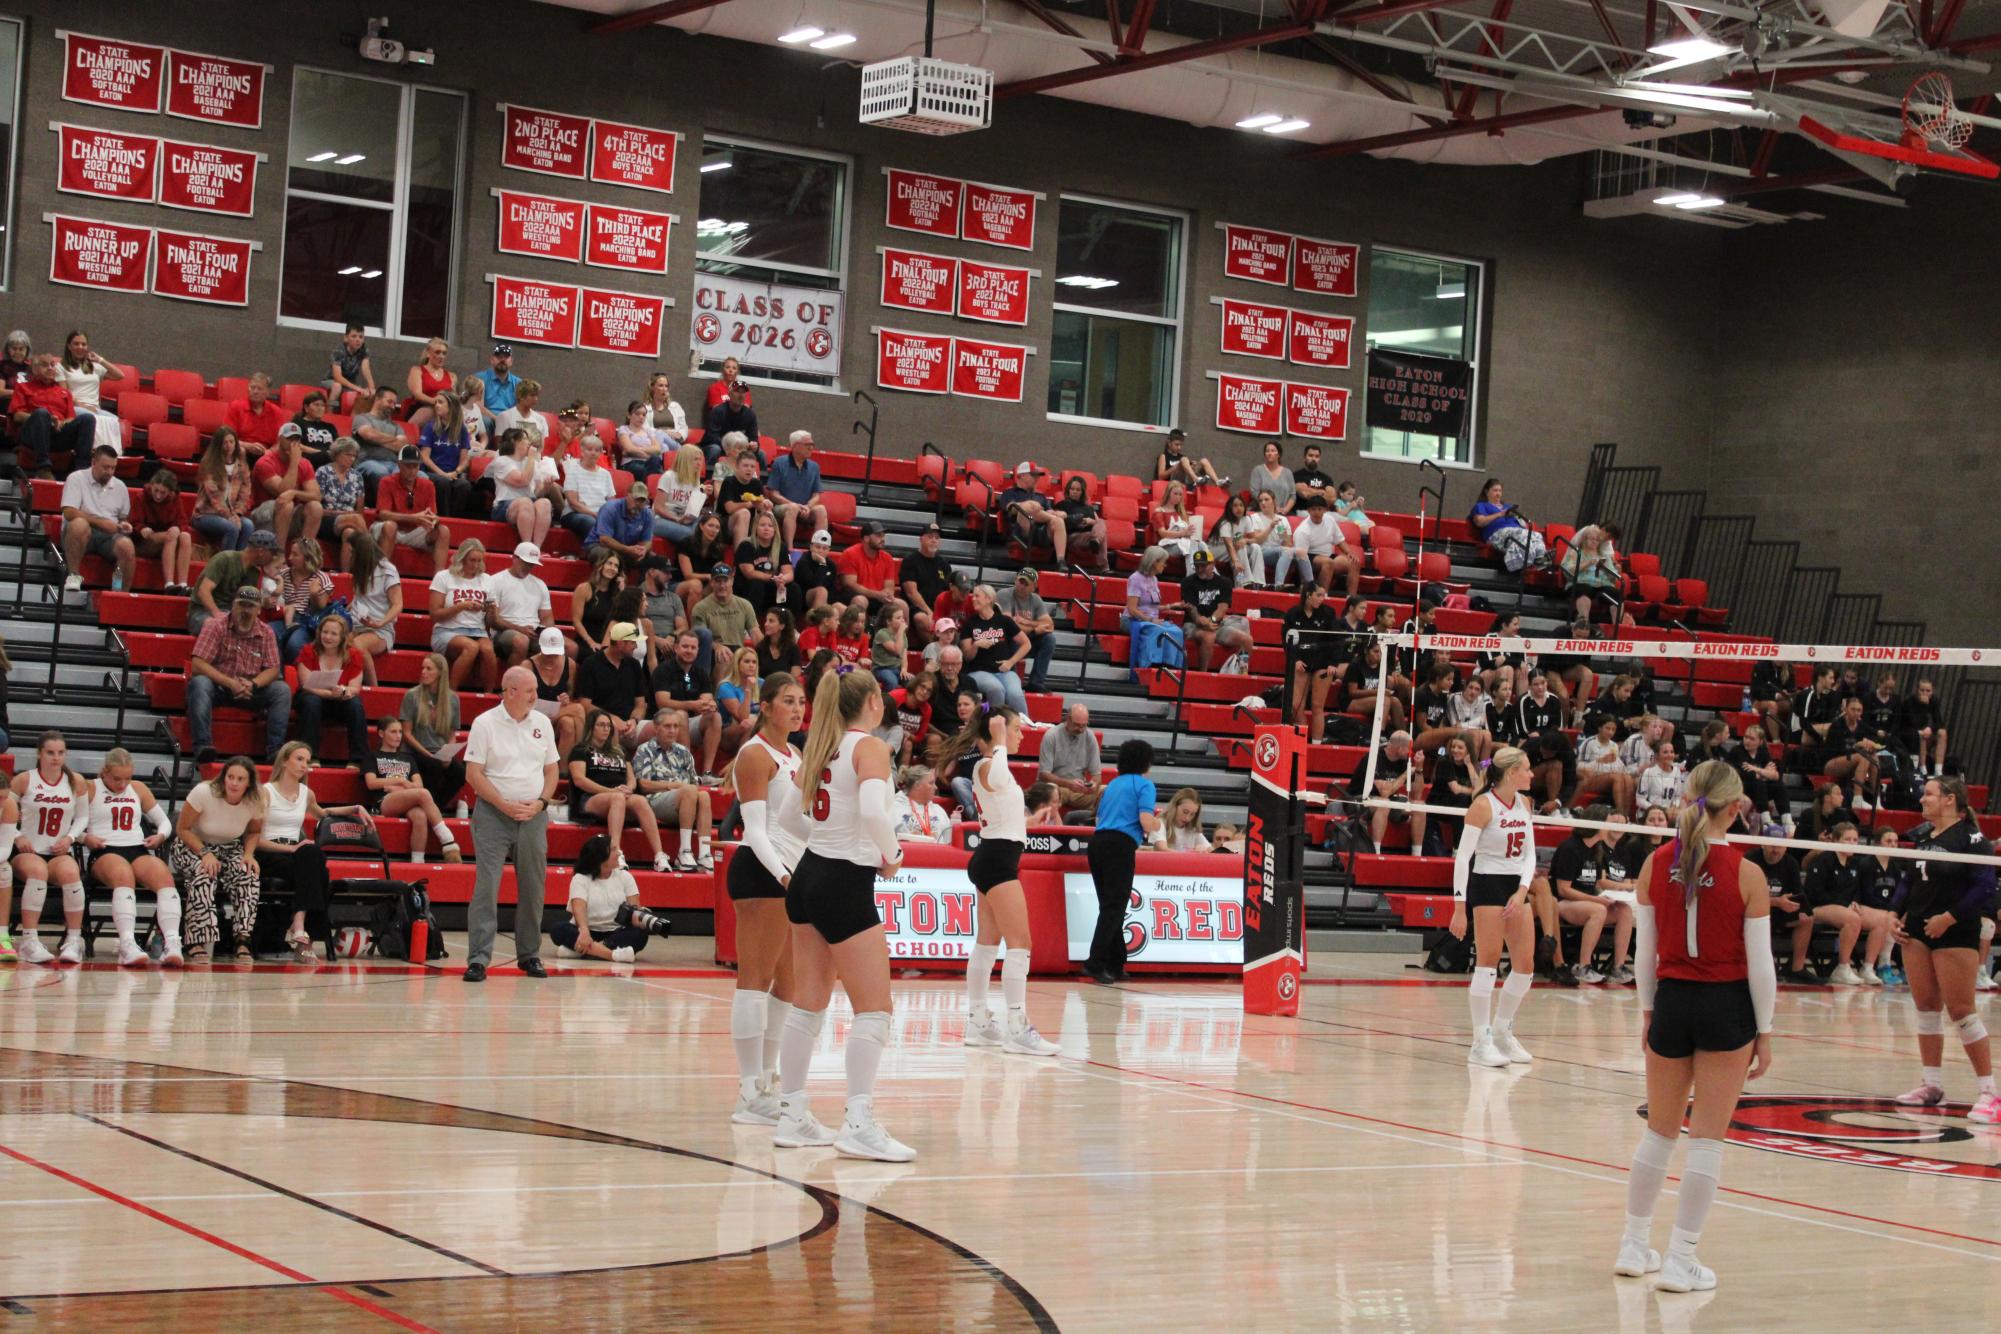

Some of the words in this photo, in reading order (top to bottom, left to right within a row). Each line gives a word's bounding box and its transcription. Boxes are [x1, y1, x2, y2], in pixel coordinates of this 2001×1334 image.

[100, 45, 129, 59] STATE
[77, 48, 151, 79] CHAMPIONS
[201, 62, 229, 74] STATE
[90, 69, 113, 80] 2020
[116, 74, 135, 85] AAA
[179, 65, 250, 94] CHAMPIONS
[92, 80, 131, 94] SOFTBALL
[193, 85, 213, 97] 2021
[216, 89, 234, 100] AAA
[100, 91, 122, 101] EATON
[194, 96, 232, 109] BASEBALL
[201, 107, 223, 117] EATON
[534, 116, 560, 128] STATE
[515, 119, 539, 138] 2ND
[542, 127, 578, 148] PLACE
[624, 130, 648, 143] STATE
[94, 136, 124, 149] STATE
[529, 138, 547, 149] 2021
[550, 142, 561, 152] AA
[604, 135, 627, 152] 4TH
[630, 142, 666, 161] PLACE
[72, 139, 145, 168] CHAMPIONS
[194, 151, 222, 163] STATE
[517, 145, 552, 159] MARCHING
[554, 154, 572, 162] BAND
[84, 160, 107, 171] 2020
[111, 164, 130, 175] AAA
[172, 154, 243, 183] CHAMPIONS
[534, 158, 553, 168] EATON
[612, 161, 630, 171] BOYS
[633, 165, 654, 175] TRACK
[83, 170, 131, 184] VOLLEYBALL
[189, 175, 208, 186] 2021
[211, 178, 223, 188] AA
[623, 171, 642, 181] EATON
[94, 181, 117, 192] EATON
[915, 179, 938, 190] STATE
[187, 186, 224, 198] FOOTBALL
[898, 182, 954, 207] CHAMPIONS
[990, 193, 1012, 204] STATE
[194, 195, 215, 205] EATON
[531, 201, 556, 212] STATE
[972, 195, 1026, 220] CHAMPIONS
[511, 203, 574, 230] CHAMPIONS
[618, 213, 644, 225] STATE
[909, 209, 939, 220] FOOTBALL
[982, 213, 998, 223] 2023
[1000, 216, 1013, 226] AAA
[915, 218, 932, 227] EATON
[984, 223, 1012, 234] BASEBALL
[88, 228, 117, 240] STATE
[597, 217, 629, 235] THIRD
[631, 226, 663, 242] PLACE
[990, 232, 1005, 240] EATON
[522, 231, 560, 244] WRESTLING
[65, 231, 117, 253] RUNNER
[121, 241, 139, 260] UP
[189, 241, 217, 253] STATE
[531, 241, 550, 251] EATON
[600, 243, 635, 255] MARCHING
[638, 249, 656, 258] BAND
[1232, 236, 1259, 252] FINAL
[1261, 243, 1285, 259] FOUR
[79, 251, 100, 262] 2021
[103, 254, 121, 265] AAA
[168, 244, 203, 264] FINAL
[206, 253, 238, 273] FOUR
[618, 254, 637, 263] EATON
[909, 258, 932, 269] STATE
[1302, 249, 1350, 269] CHAMPIONS
[78, 261, 121, 275] WRESTLING
[181, 264, 201, 275] 2021
[204, 267, 222, 278] AAA
[891, 260, 919, 279] FINAL
[921, 268, 948, 286] FOUR
[87, 272, 109, 282] EATON
[182, 274, 219, 287] SOFTBALL
[984, 271, 1005, 280] STATE
[189, 285, 210, 295] EATON
[966, 274, 987, 290] 3RD
[990, 280, 1019, 296] PLACE
[524, 286, 549, 298] STATE
[900, 287, 936, 299] VOLLEYBALL
[976, 290, 993, 301] 2023
[995, 293, 1008, 302] AAA
[505, 290, 568, 315] CHAMPIONS
[610, 298, 636, 308] STATE
[696, 288, 784, 319] CLASS
[797, 302, 834, 326] OF
[909, 297, 926, 305] EATON
[973, 299, 988, 308] BOYS
[991, 302, 1010, 311] TRACK
[590, 300, 653, 326] CHAMPIONS
[983, 308, 999, 317] EATON
[518, 318, 552, 330] BASEBALL
[1228, 311, 1255, 326] FINAL
[1258, 318, 1282, 332] FOUR
[524, 328, 543, 337] EATON
[603, 328, 637, 340] SOFTBALL
[731, 322, 795, 349] 2026
[1295, 321, 1321, 337] FINAL
[1323, 328, 1346, 342] FOUR
[609, 338, 628, 348] EATON
[904, 339, 927, 348] STATE
[886, 341, 942, 363] CHAMPIONS
[982, 349, 999, 358] STATE
[897, 358, 914, 368] 2023
[916, 361, 930, 371] AAA
[959, 351, 990, 368] FINAL
[992, 358, 1018, 373] FOUR
[896, 368, 929, 378] WRESTLING
[1395, 366, 1443, 382] EATON
[904, 377, 920, 386] EATON
[975, 376, 1000, 385] FOOTBALL
[1242, 383, 1262, 391] STATE
[979, 383, 995, 392] EATON
[1307, 389, 1327, 399] STATE
[1369, 377, 1407, 392] HIGH
[1412, 383, 1466, 400] SCHOOL
[1226, 385, 1275, 406] CHAMPIONS
[1384, 393, 1427, 409] CLASS
[1432, 401, 1450, 411] OF
[1252, 404, 1263, 413] AAA
[1291, 392, 1316, 409] FINAL
[1319, 399, 1341, 414] FOUR
[1319, 411, 1330, 419] AAA
[1400, 409, 1432, 423] 2029
[453, 589, 487, 600] EATO
[973, 628, 1004, 640] Eaton
[1430, 636, 1467, 647] EATON
[1470, 638, 1500, 648] REDS
[1556, 640, 1596, 651] EATON
[1599, 641, 1633, 653] REDS
[1693, 643, 1739, 655] EATON
[1741, 645, 1779, 657] REDS
[1845, 647, 1895, 660] EATON
[1897, 649, 1940, 661] REDS
[33, 794, 70, 803] Eaton
[38, 807, 64, 836] 18
[111, 806, 133, 831] 10
[1500, 819, 1526, 828] Eaton
[1025, 837, 1049, 850] POSS
[1505, 832, 1525, 858] 15
[907, 874, 917, 883] to
[1246, 814, 1264, 932] EATON
[1263, 842, 1274, 905] REDS
[1669, 868, 1715, 887] Rds
[1154, 880, 1183, 892] Home
[1187, 881, 1196, 894] of
[1200, 882, 1214, 892] the
[874, 891, 975, 936] TON
[1150, 898, 1244, 941] RED
